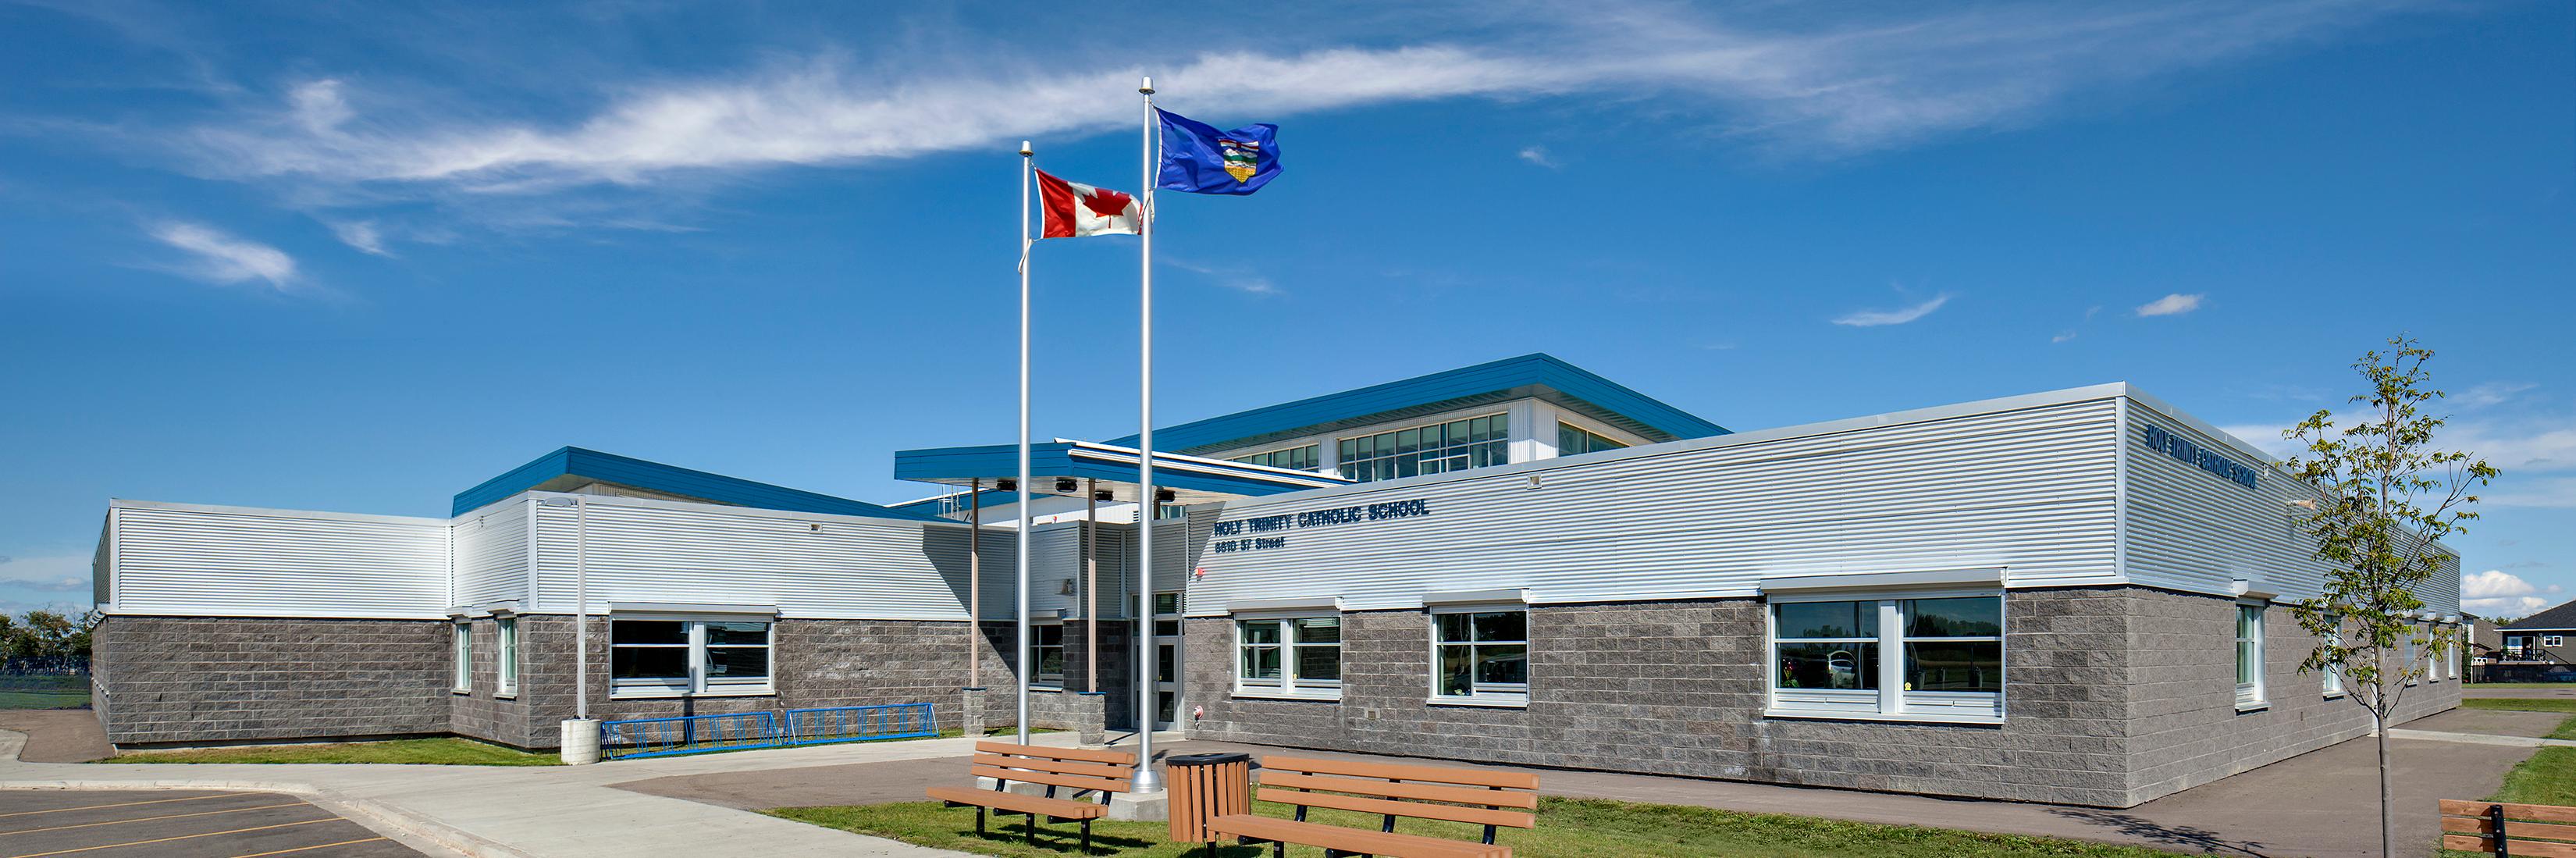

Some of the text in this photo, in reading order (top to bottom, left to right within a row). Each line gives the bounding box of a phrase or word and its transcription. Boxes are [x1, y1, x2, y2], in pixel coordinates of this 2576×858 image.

[2147, 424, 2257, 489] HOLY TRINITY CATHOLIC SCHOOL
[1215, 499, 1430, 536] HOLY TRINITY CATHOLIC SCHOOL
[1240, 539, 1252, 551] 57
[1255, 536, 1286, 550] Street
